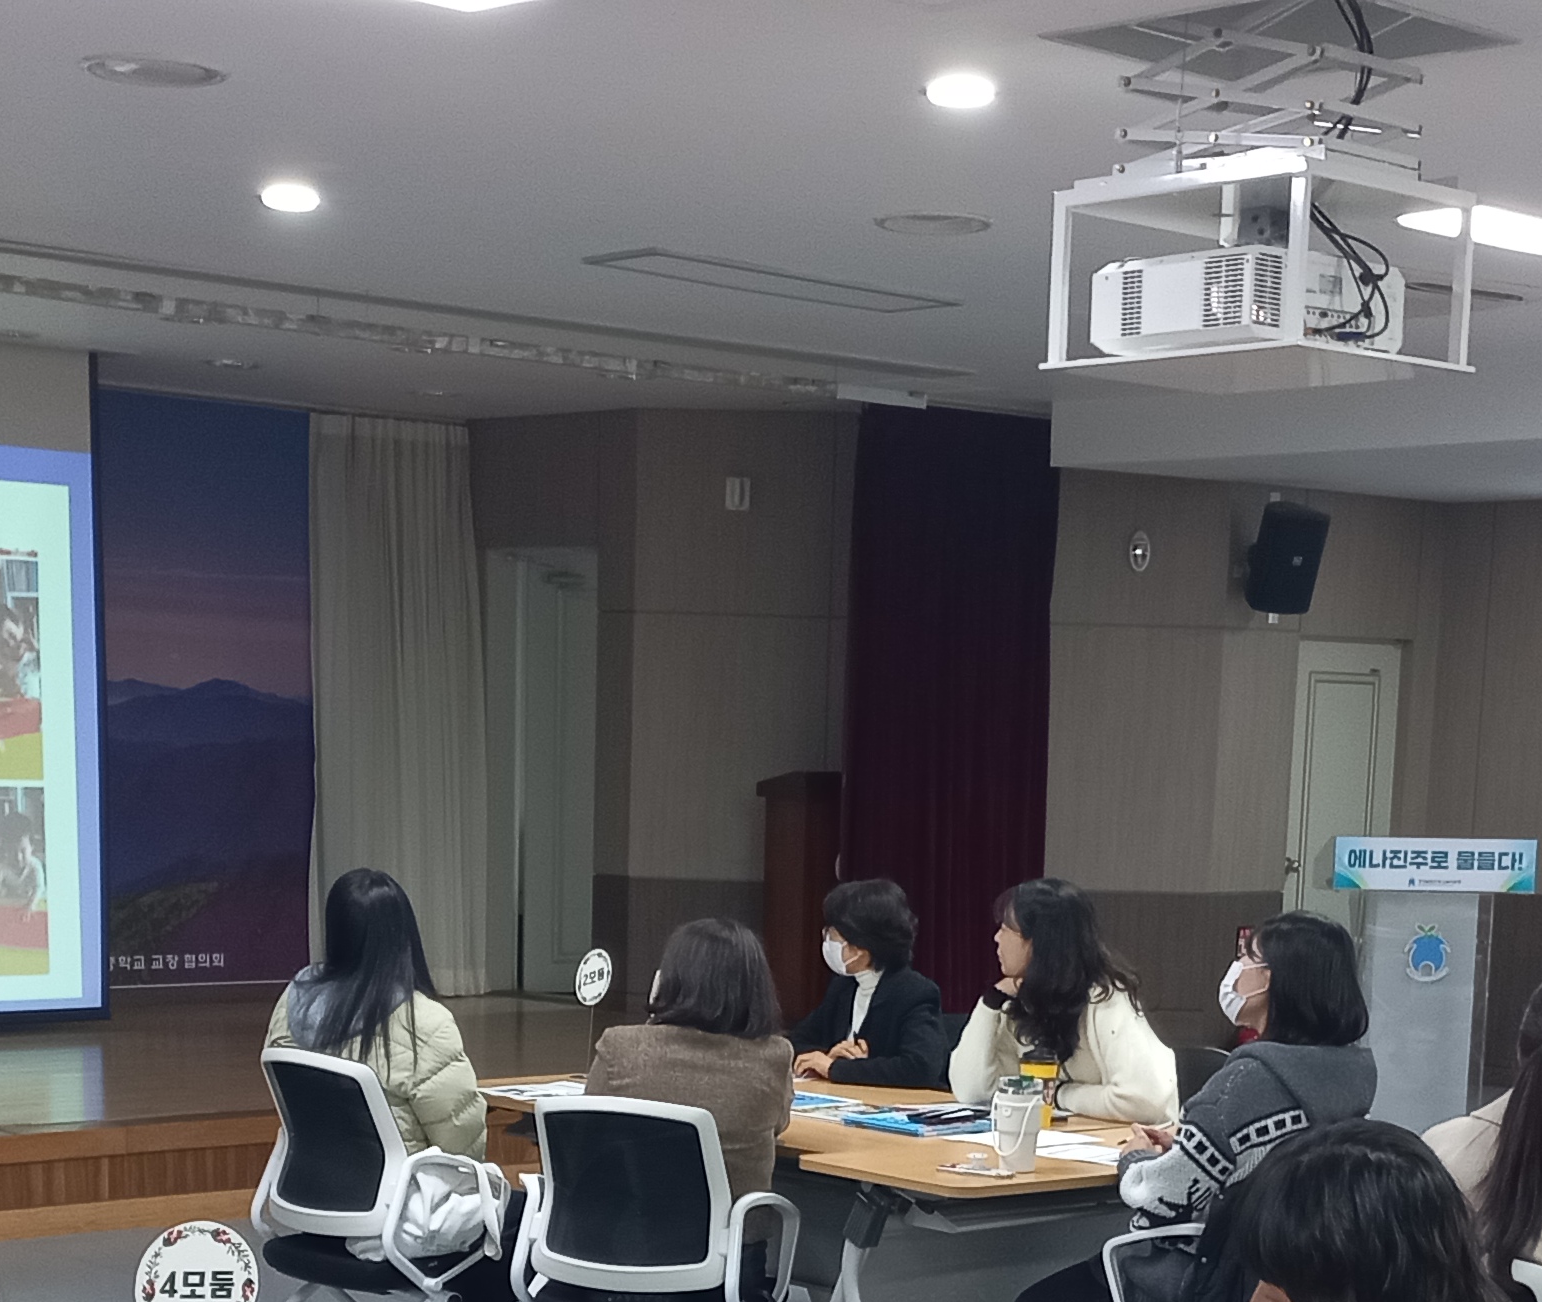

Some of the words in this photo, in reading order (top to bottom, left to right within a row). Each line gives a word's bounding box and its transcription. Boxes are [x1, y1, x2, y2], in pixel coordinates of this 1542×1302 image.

[1347, 849, 1449, 870] 에나진주로
[1456, 851, 1524, 871] 물들다!
[151, 954, 179, 970] 교장
[184, 953, 224, 969] 협의회
[159, 1270, 235, 1299] 4모둠
